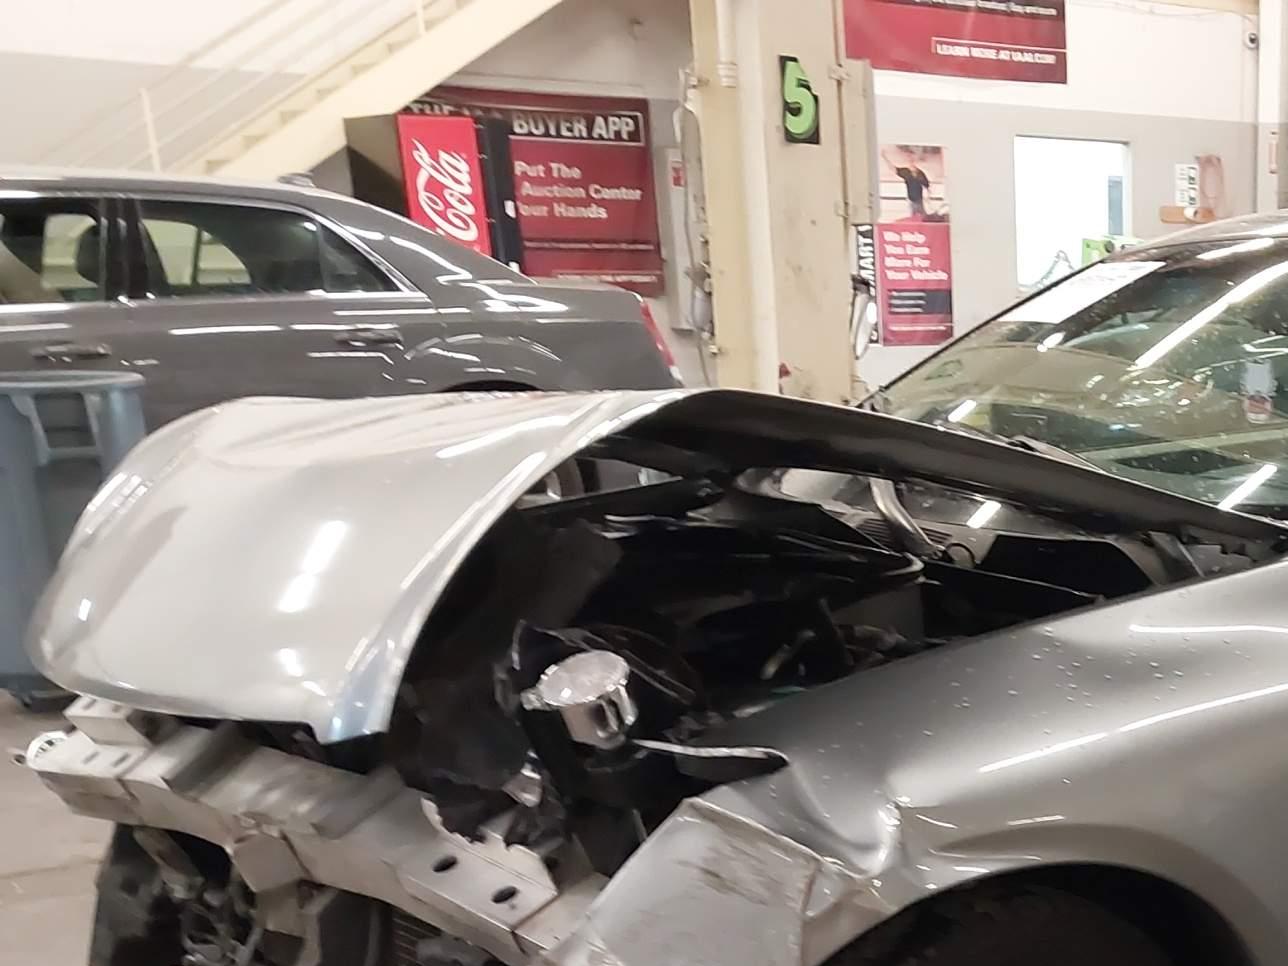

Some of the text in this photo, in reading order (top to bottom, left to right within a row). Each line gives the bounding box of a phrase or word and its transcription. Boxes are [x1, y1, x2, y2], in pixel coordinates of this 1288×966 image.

[783, 60, 818, 137] 5
[511, 114, 588, 138] BUYER
[591, 116, 635, 140] APP
[514, 160, 581, 179] Put The
[521, 181, 643, 200] Auction Center
[553, 202, 608, 218] Hands
